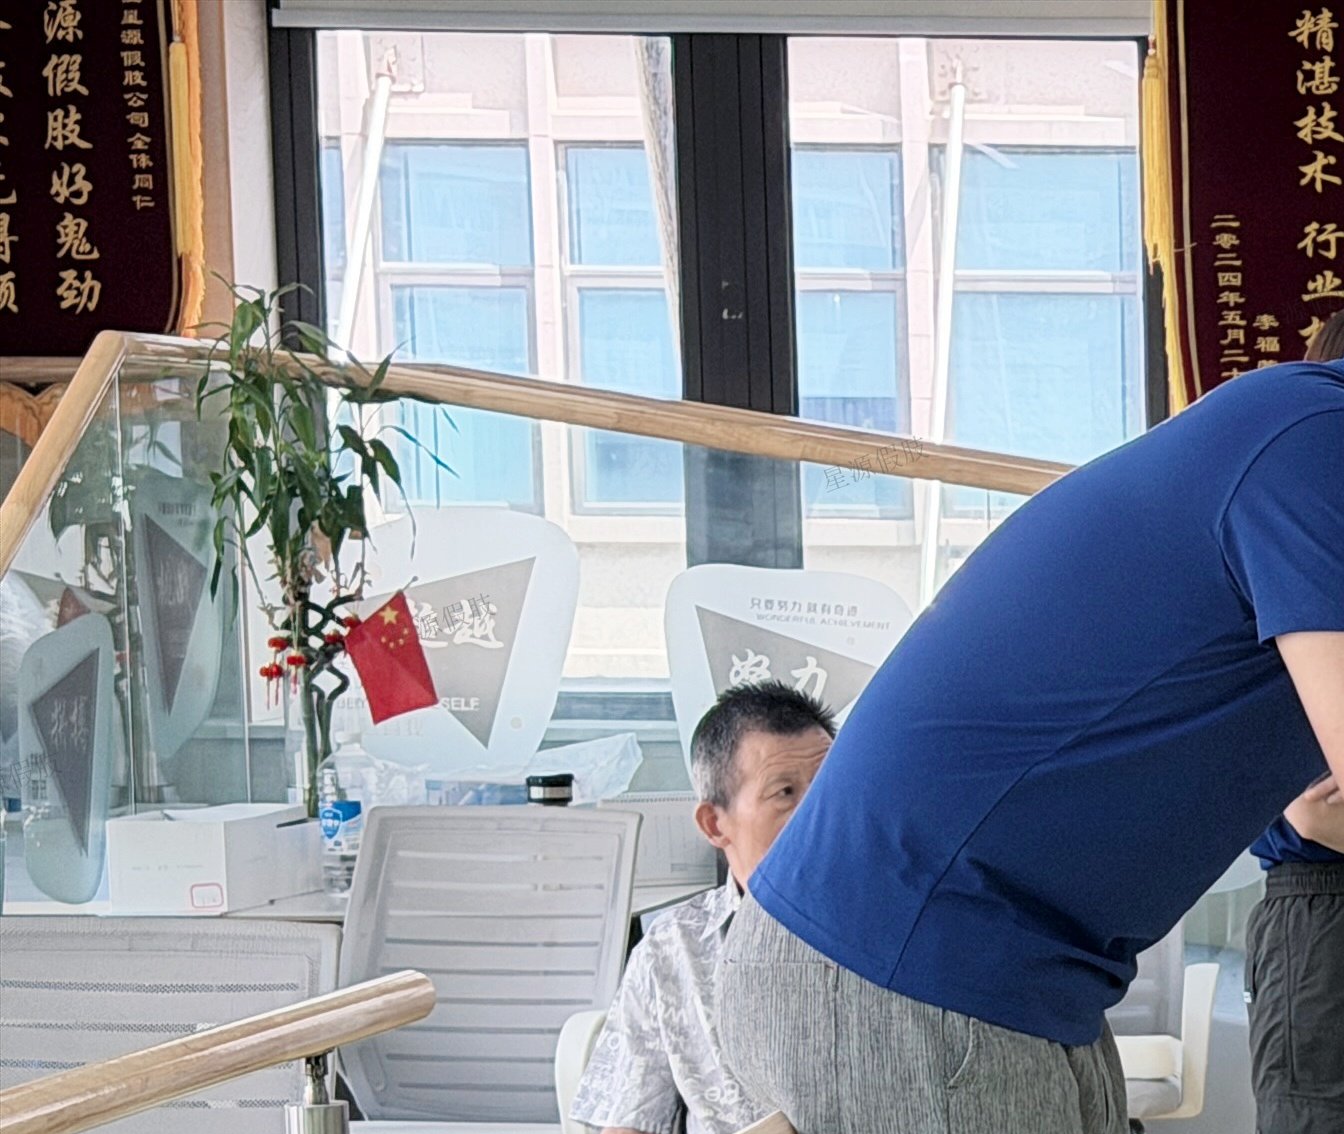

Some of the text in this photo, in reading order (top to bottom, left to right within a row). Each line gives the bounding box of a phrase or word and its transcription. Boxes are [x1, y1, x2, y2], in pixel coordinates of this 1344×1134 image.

[120, 0, 155, 210] 星源假肢公司全体同仁
[1288, 7, 1344, 193] 精湛技术
[750, 596, 803, 613] 只要努力
